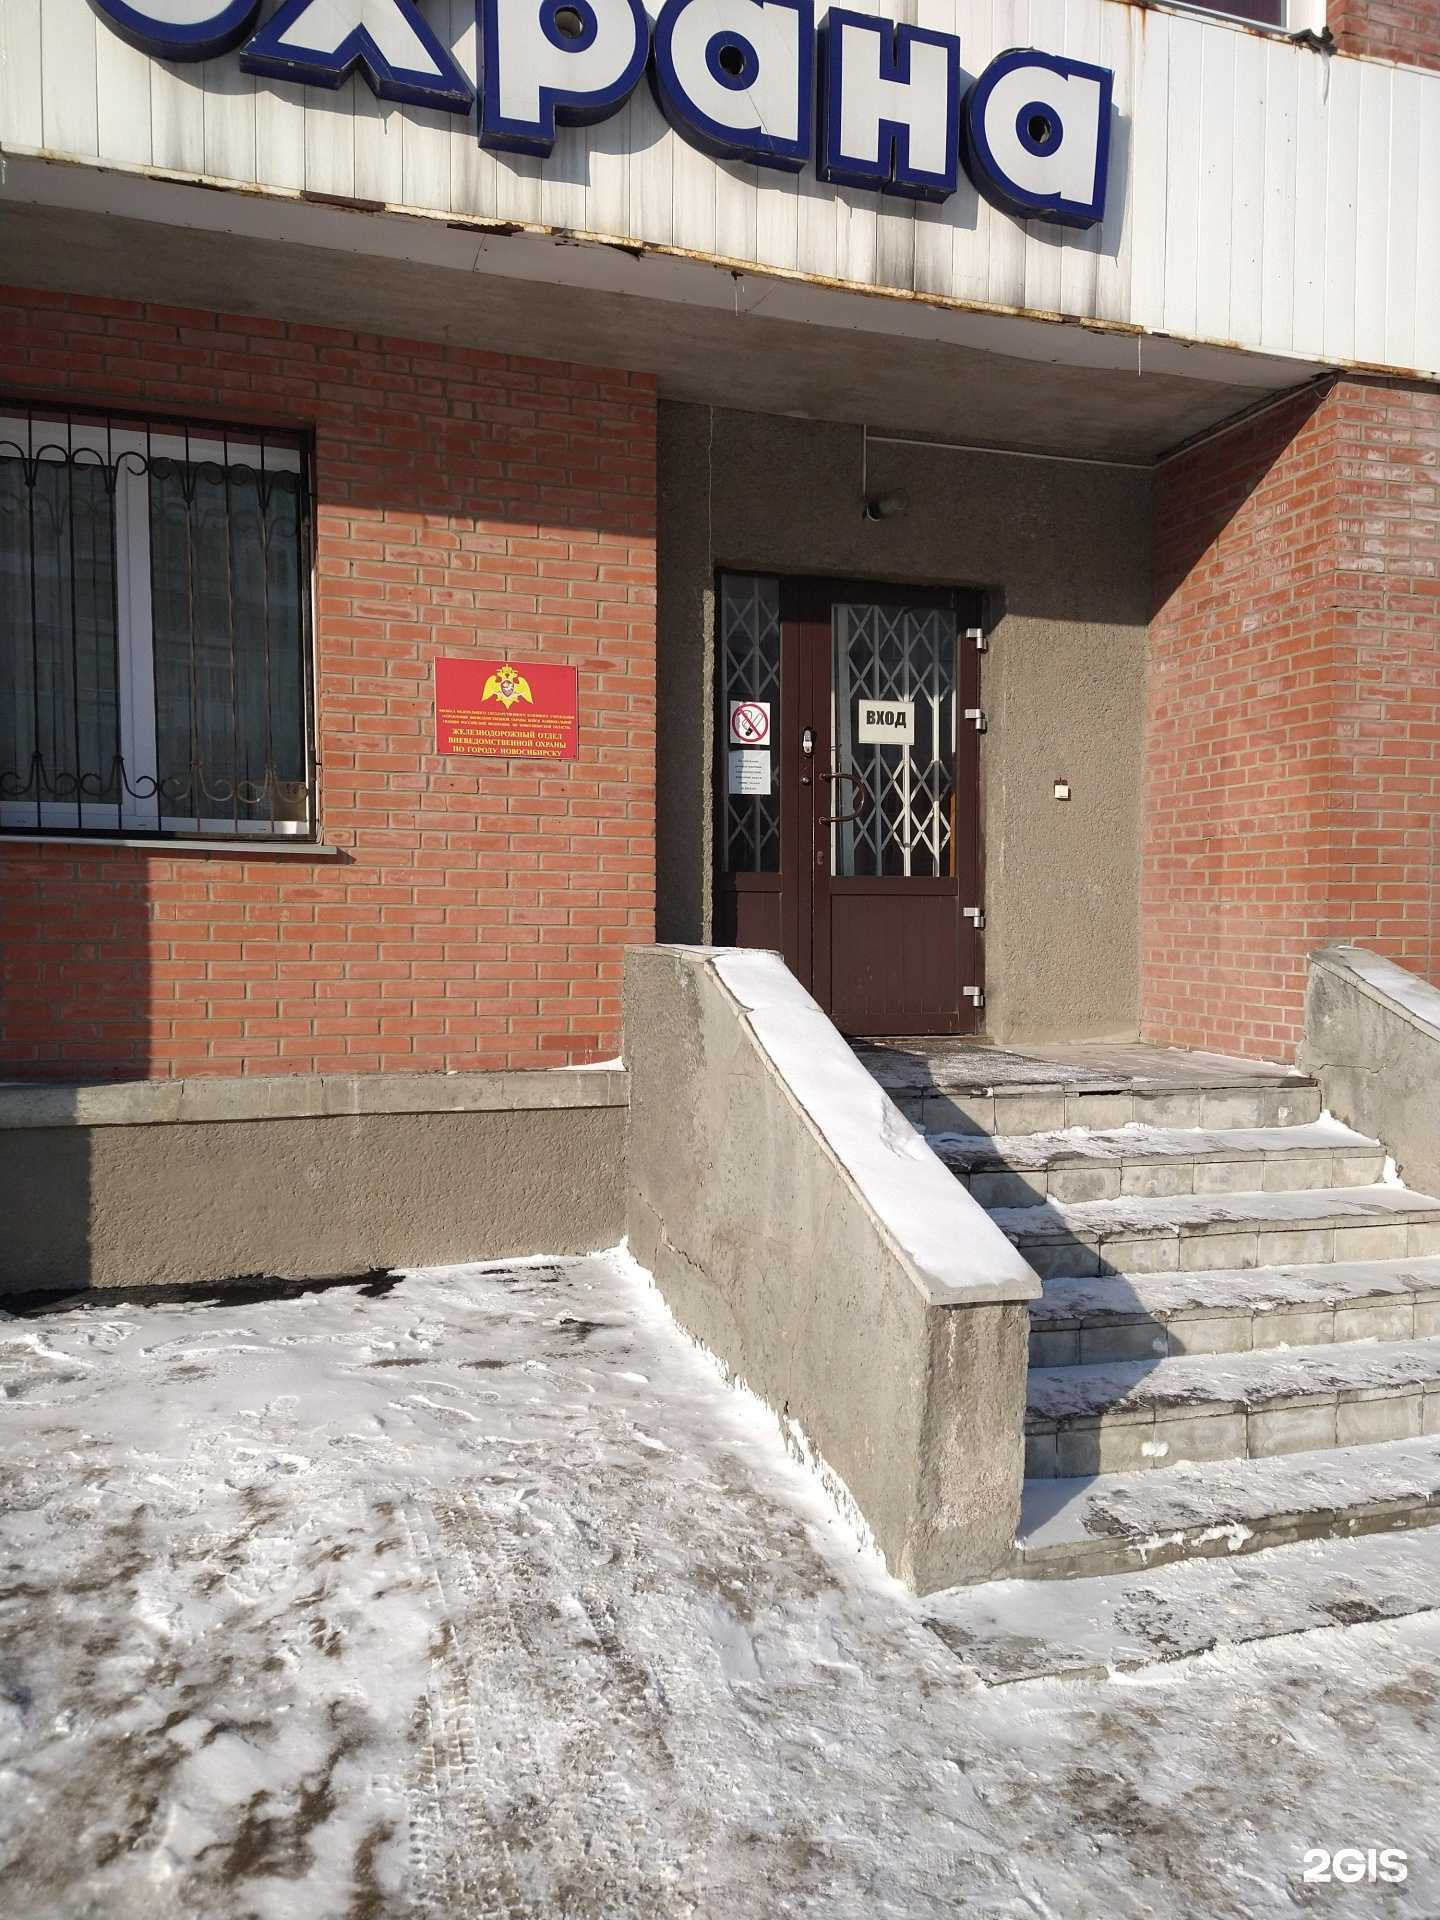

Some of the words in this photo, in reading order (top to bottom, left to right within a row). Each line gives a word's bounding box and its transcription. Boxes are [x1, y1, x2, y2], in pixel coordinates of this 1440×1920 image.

[866, 710, 907, 728] ВХОД
[537, 732, 562, 740] ОТДЕЛ
[535, 741, 567, 749] ОХРАНЫ
[467, 746, 497, 754] ГОРОДУ
[500, 748, 562, 757] НОВОСИБИРСКУ
